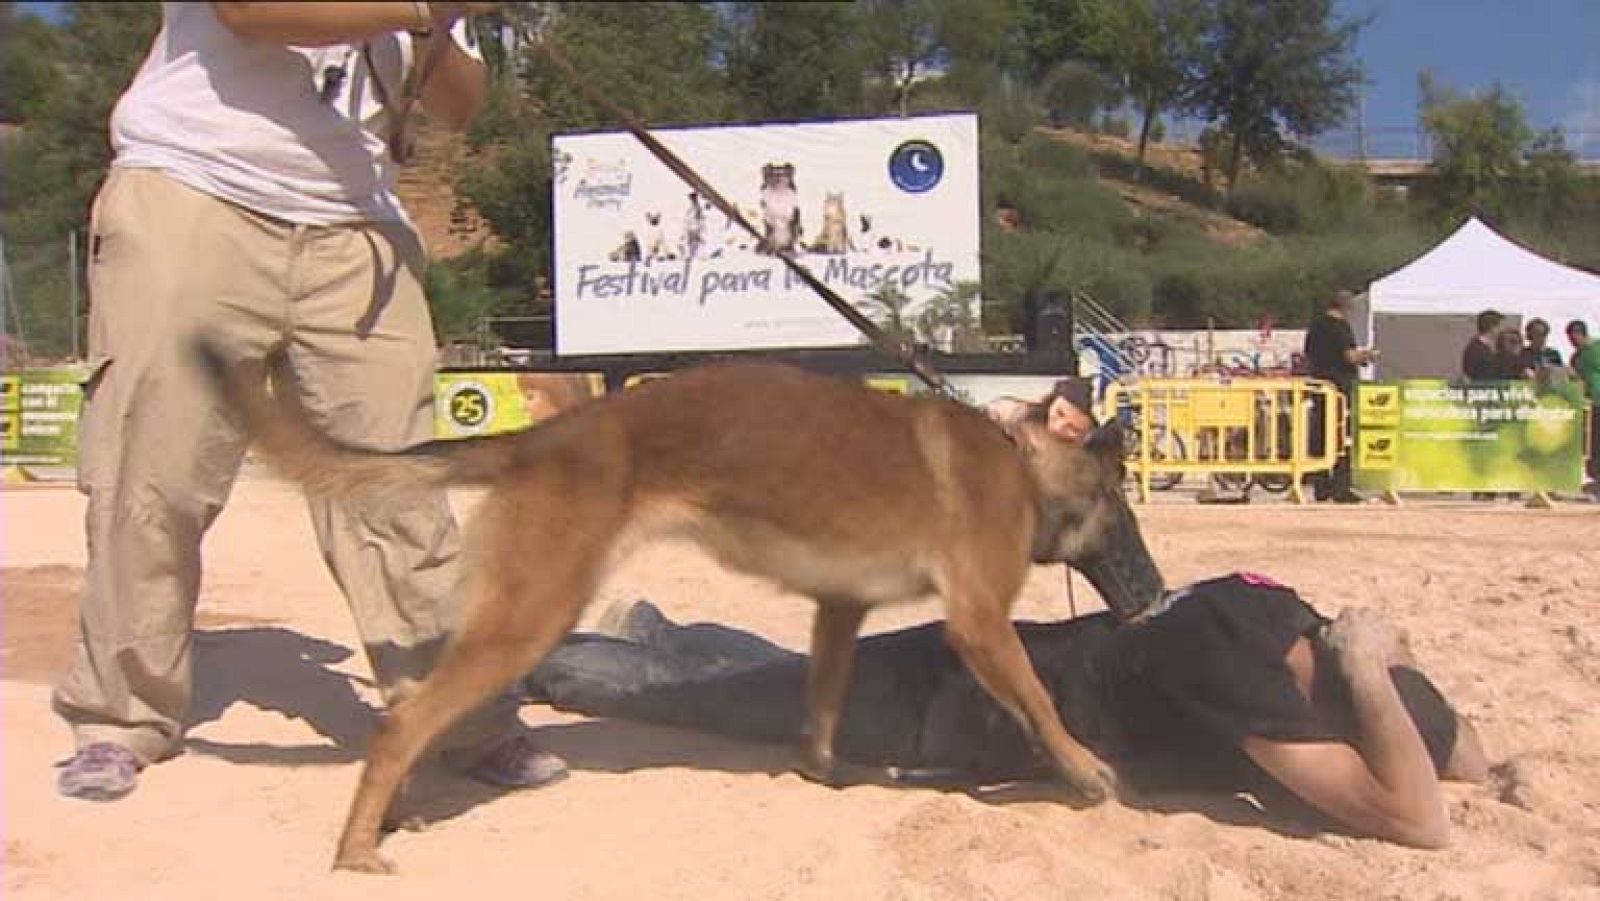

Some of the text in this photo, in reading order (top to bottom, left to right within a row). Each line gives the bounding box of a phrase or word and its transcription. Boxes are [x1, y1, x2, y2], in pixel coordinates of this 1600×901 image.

[576, 257, 693, 300] Festival
[699, 267, 771, 304] para
[824, 250, 953, 288] Mascota
[1467, 387, 1500, 405] para
[454, 394, 483, 422] 25
[1481, 408, 1513, 424] para
